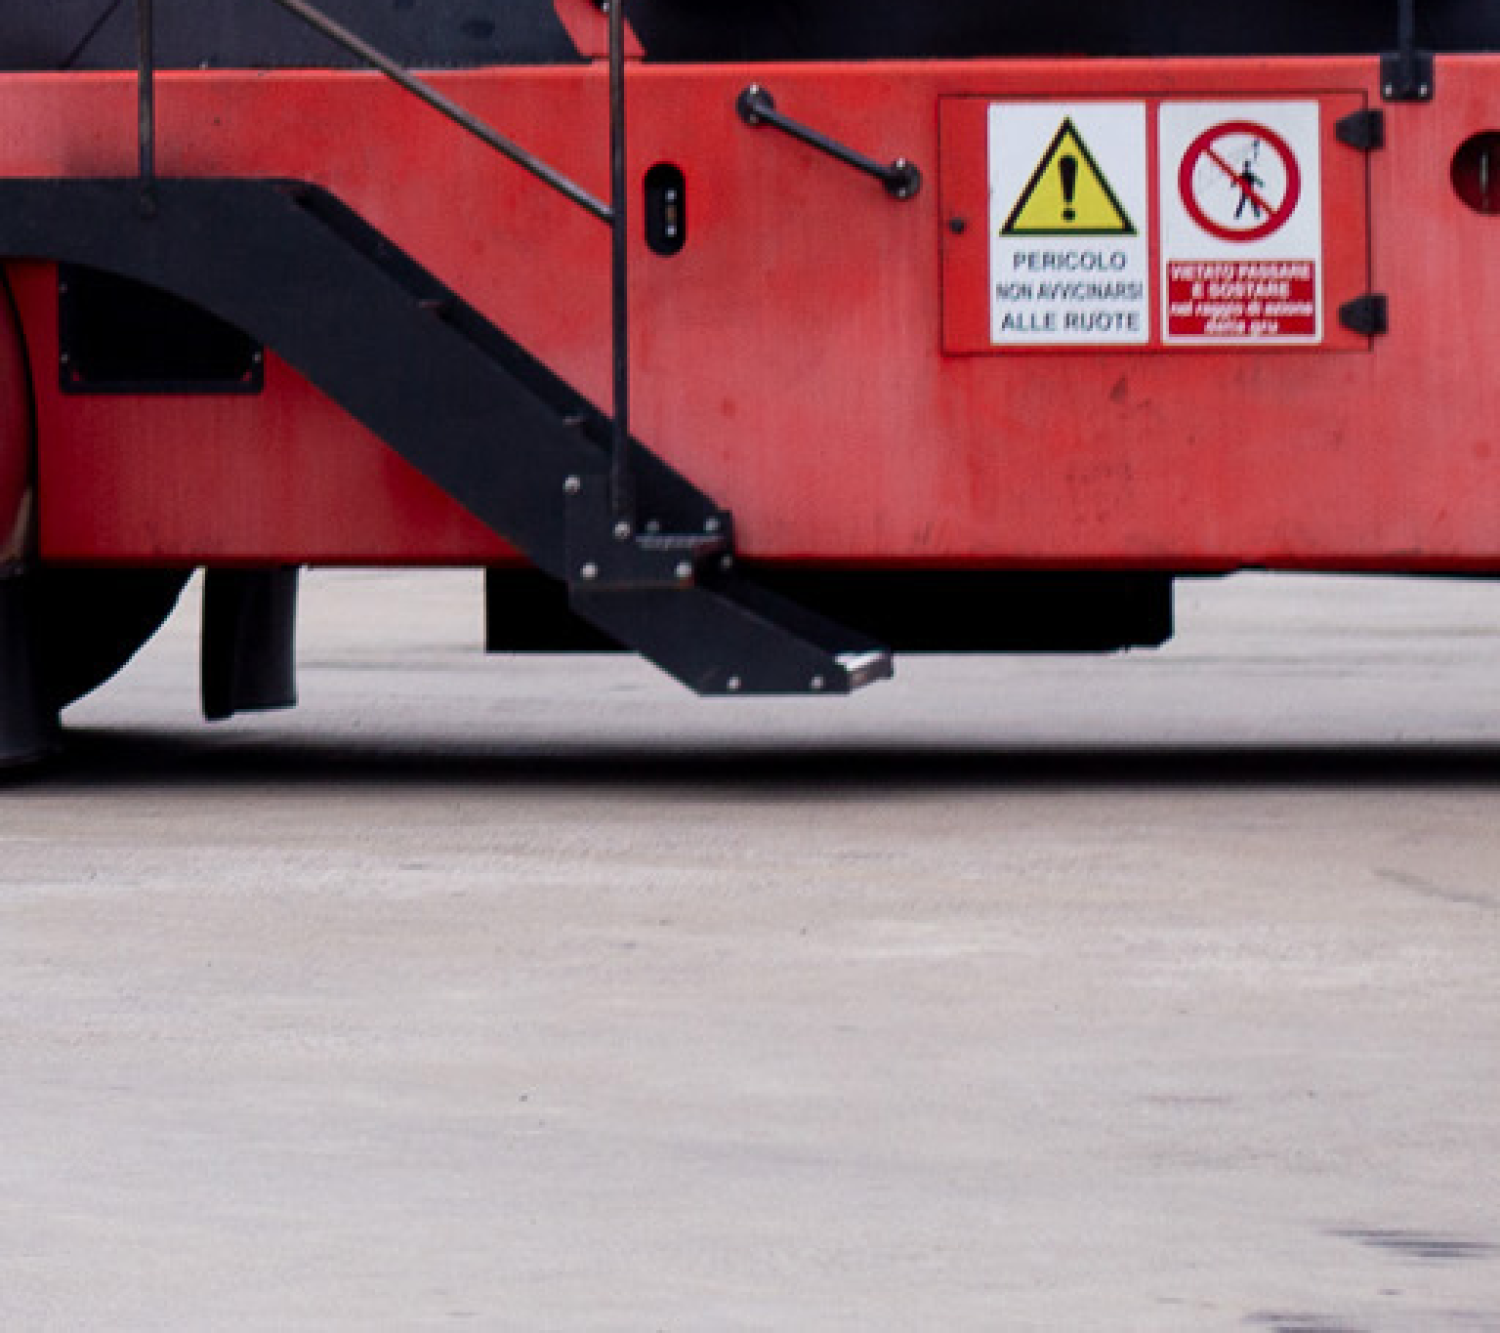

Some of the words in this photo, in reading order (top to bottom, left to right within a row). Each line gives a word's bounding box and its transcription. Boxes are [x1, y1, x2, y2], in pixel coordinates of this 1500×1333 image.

[1012, 252, 1127, 272] PERICOLO
[1171, 263, 1234, 281] VIETATO
[996, 283, 1033, 301] NON
[1037, 282, 1144, 302] AVVICINARSI
[1208, 281, 1290, 298] SOSTARE
[1001, 312, 1057, 332] ALLE
[1064, 312, 1141, 332] RUOTE
